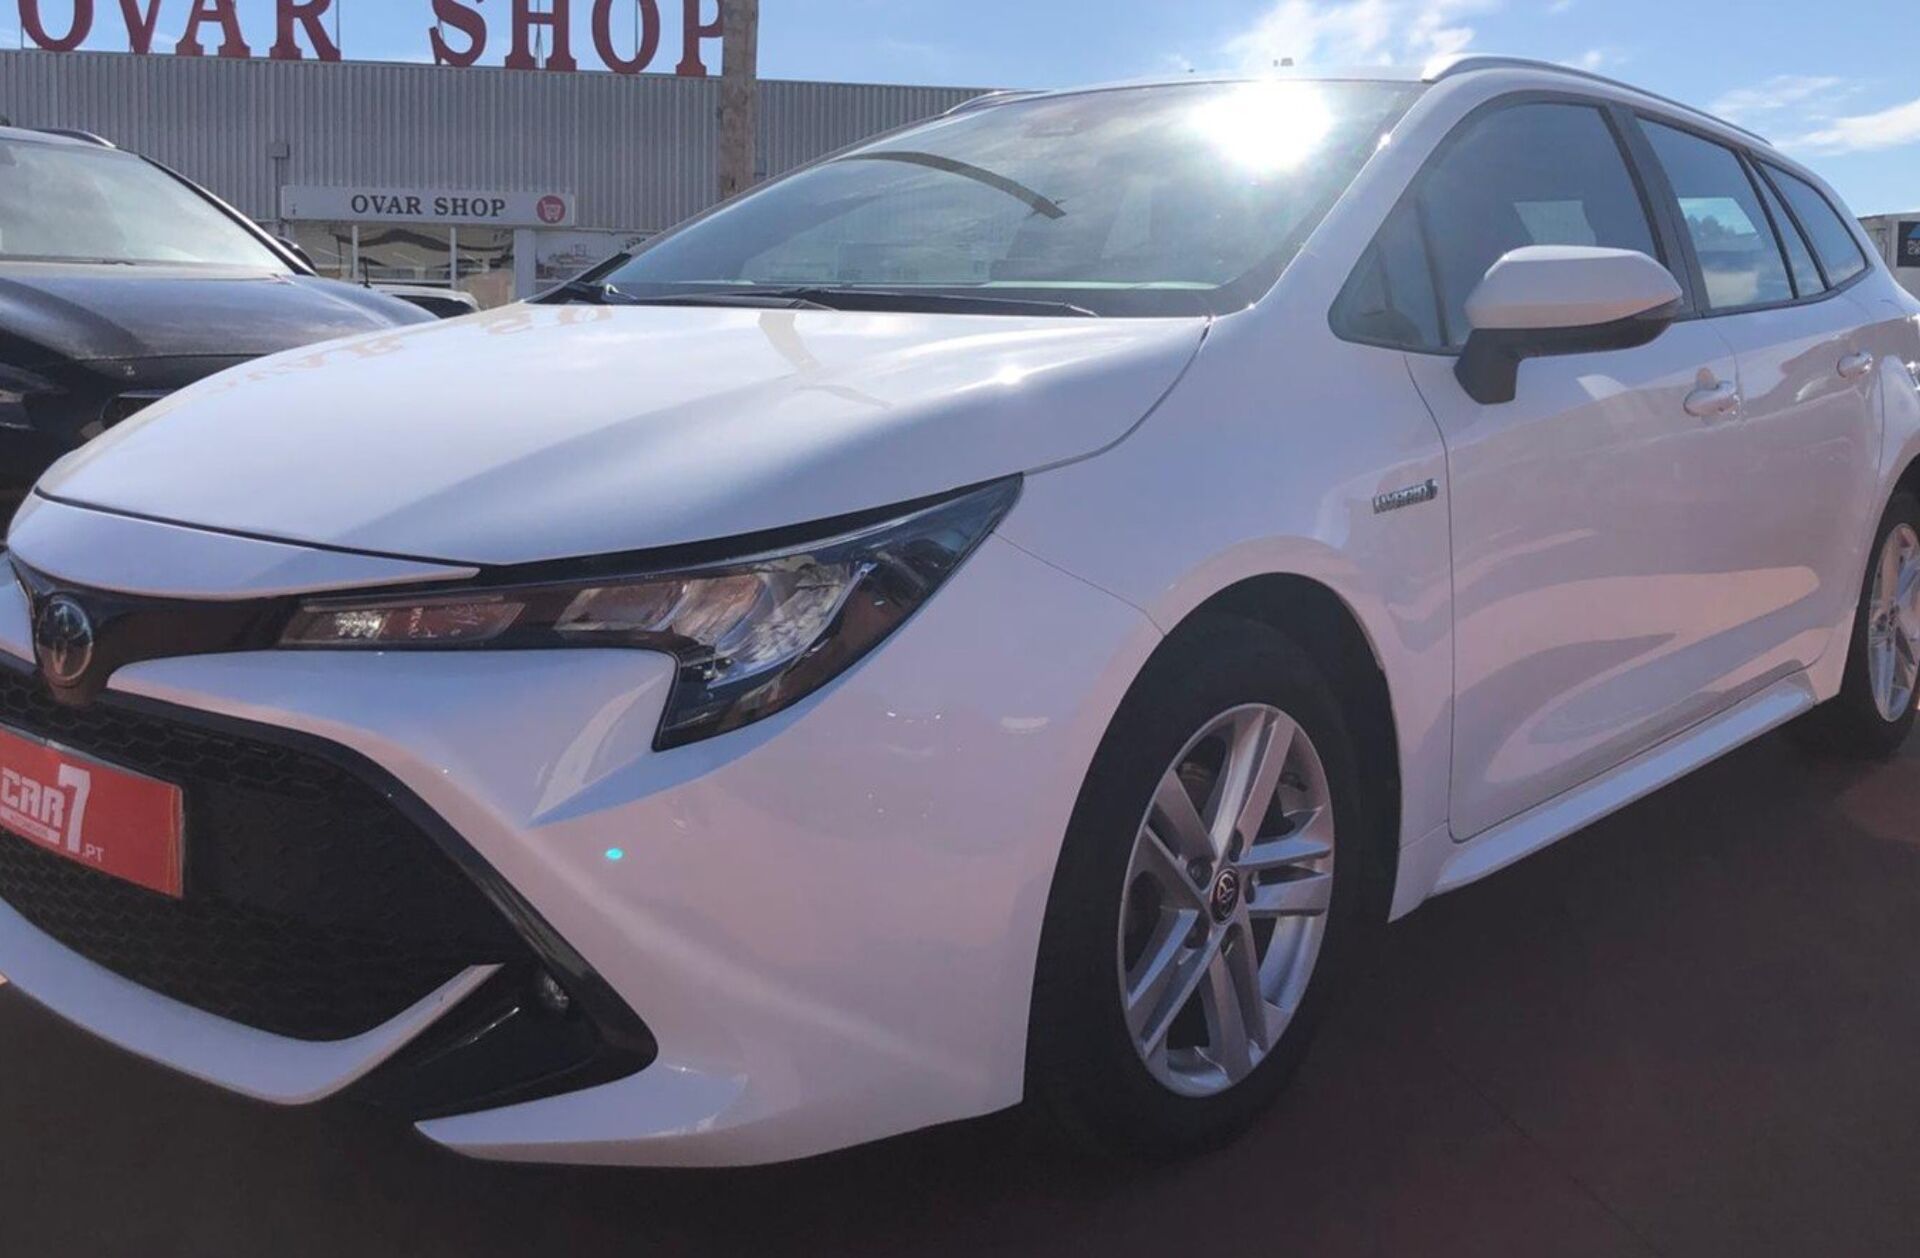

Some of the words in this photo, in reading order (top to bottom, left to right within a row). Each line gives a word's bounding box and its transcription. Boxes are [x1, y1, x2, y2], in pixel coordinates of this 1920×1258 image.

[20, 0, 342, 61] OVAR
[429, 0, 724, 77] SHOP
[351, 194, 423, 215] OVAR
[433, 197, 506, 217] SHOP
